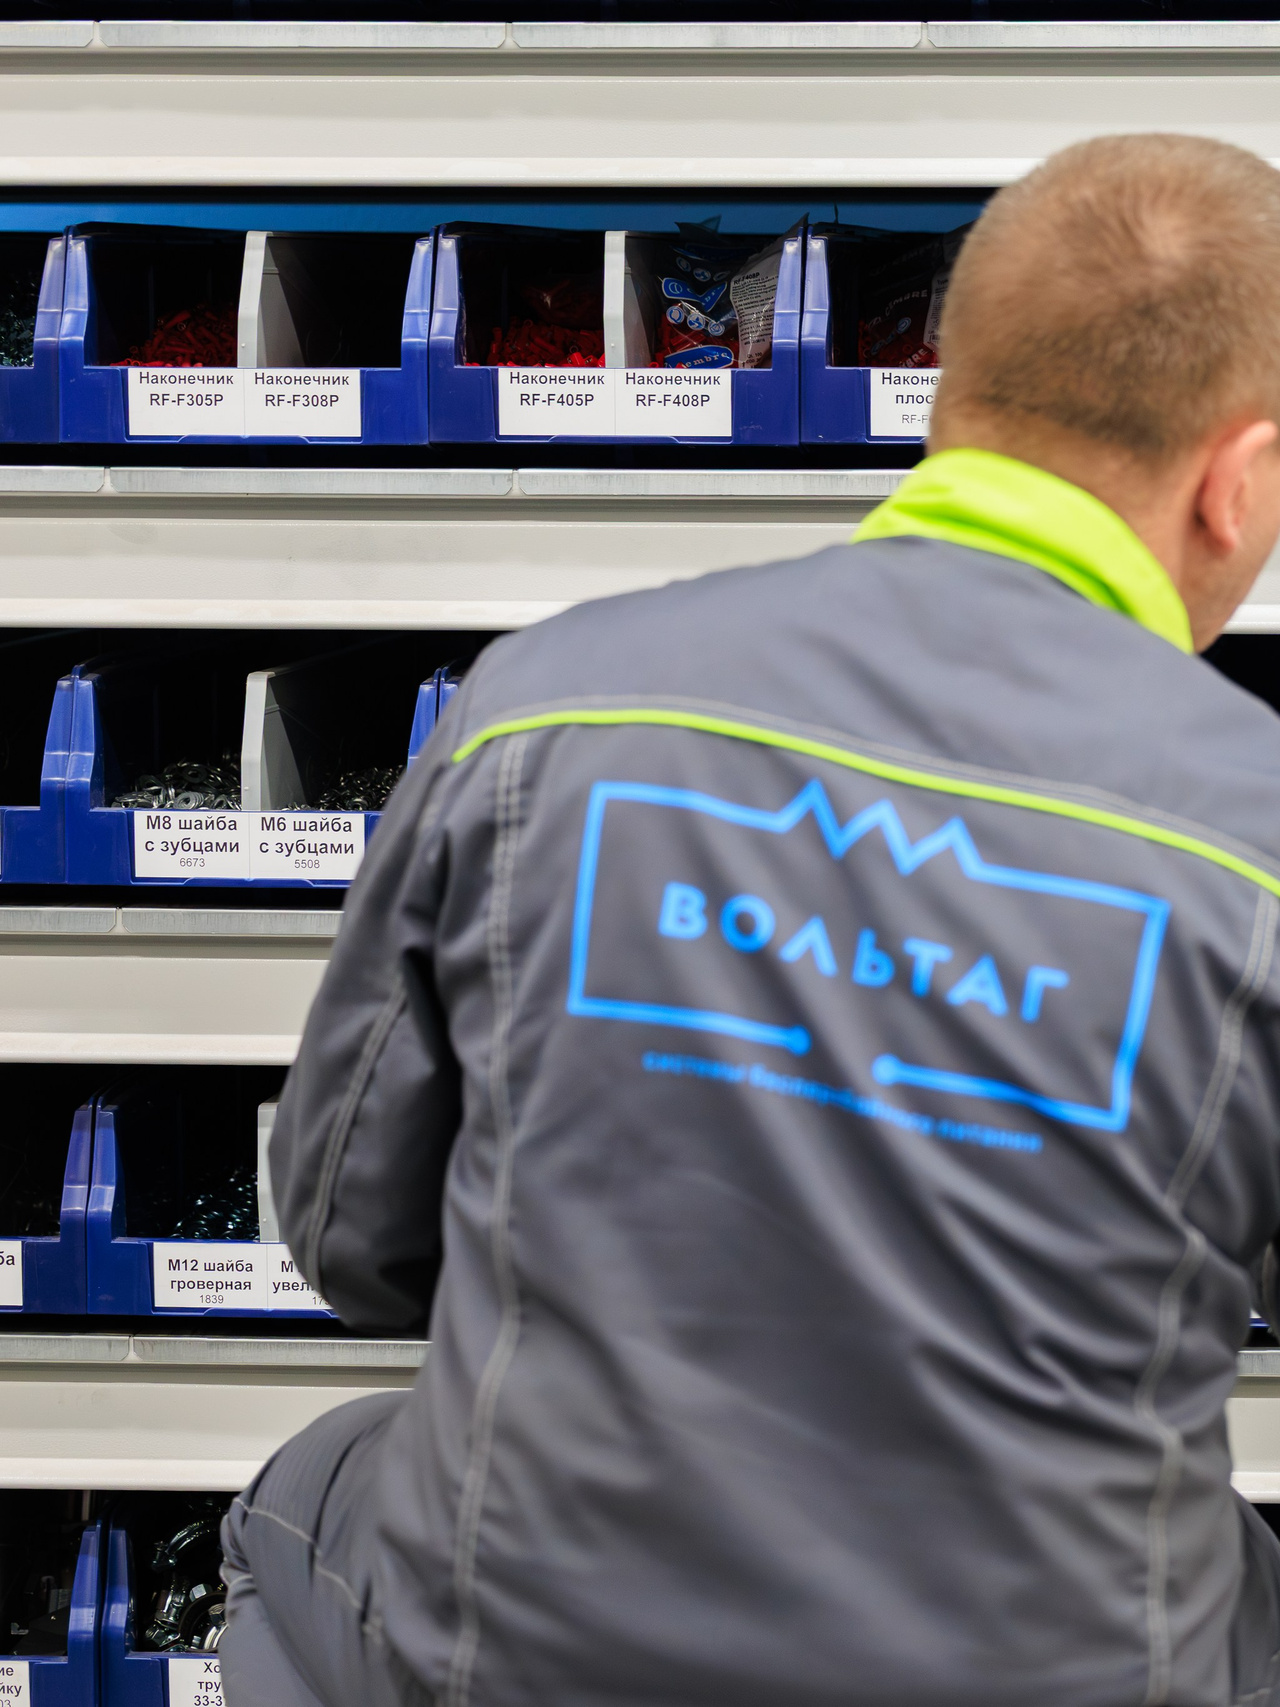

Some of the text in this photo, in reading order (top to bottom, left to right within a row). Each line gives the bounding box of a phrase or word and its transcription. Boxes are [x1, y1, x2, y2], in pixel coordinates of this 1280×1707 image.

[139, 371, 234, 385] Наконечник
[254, 372, 350, 386] Наконечник
[509, 371, 605, 385] Наконечник
[625, 371, 721, 386] Наконечник
[149, 393, 224, 407] RF-F305P
[265, 394, 340, 408] RF-F308P
[520, 393, 595, 407] RF-F405P
[635, 393, 711, 407] RF-F408P
[902, 415, 931, 424] RF-F
[146, 814, 238, 831] М8 шайба
[261, 816, 353, 833] М6 шайба
[144, 837, 240, 856] с зубцами
[259, 838, 354, 858] с зубцами
[179, 857, 206, 868] 6673
[294, 858, 321, 869] 5508
[658, 881, 1070, 1024] ВОЛЬТАГ
[168, 1258, 254, 1273] М12 шайба
[170, 1279, 252, 1293] гроверная
[272, 1281, 314, 1294] увел
[199, 1294, 224, 1305] 1839
